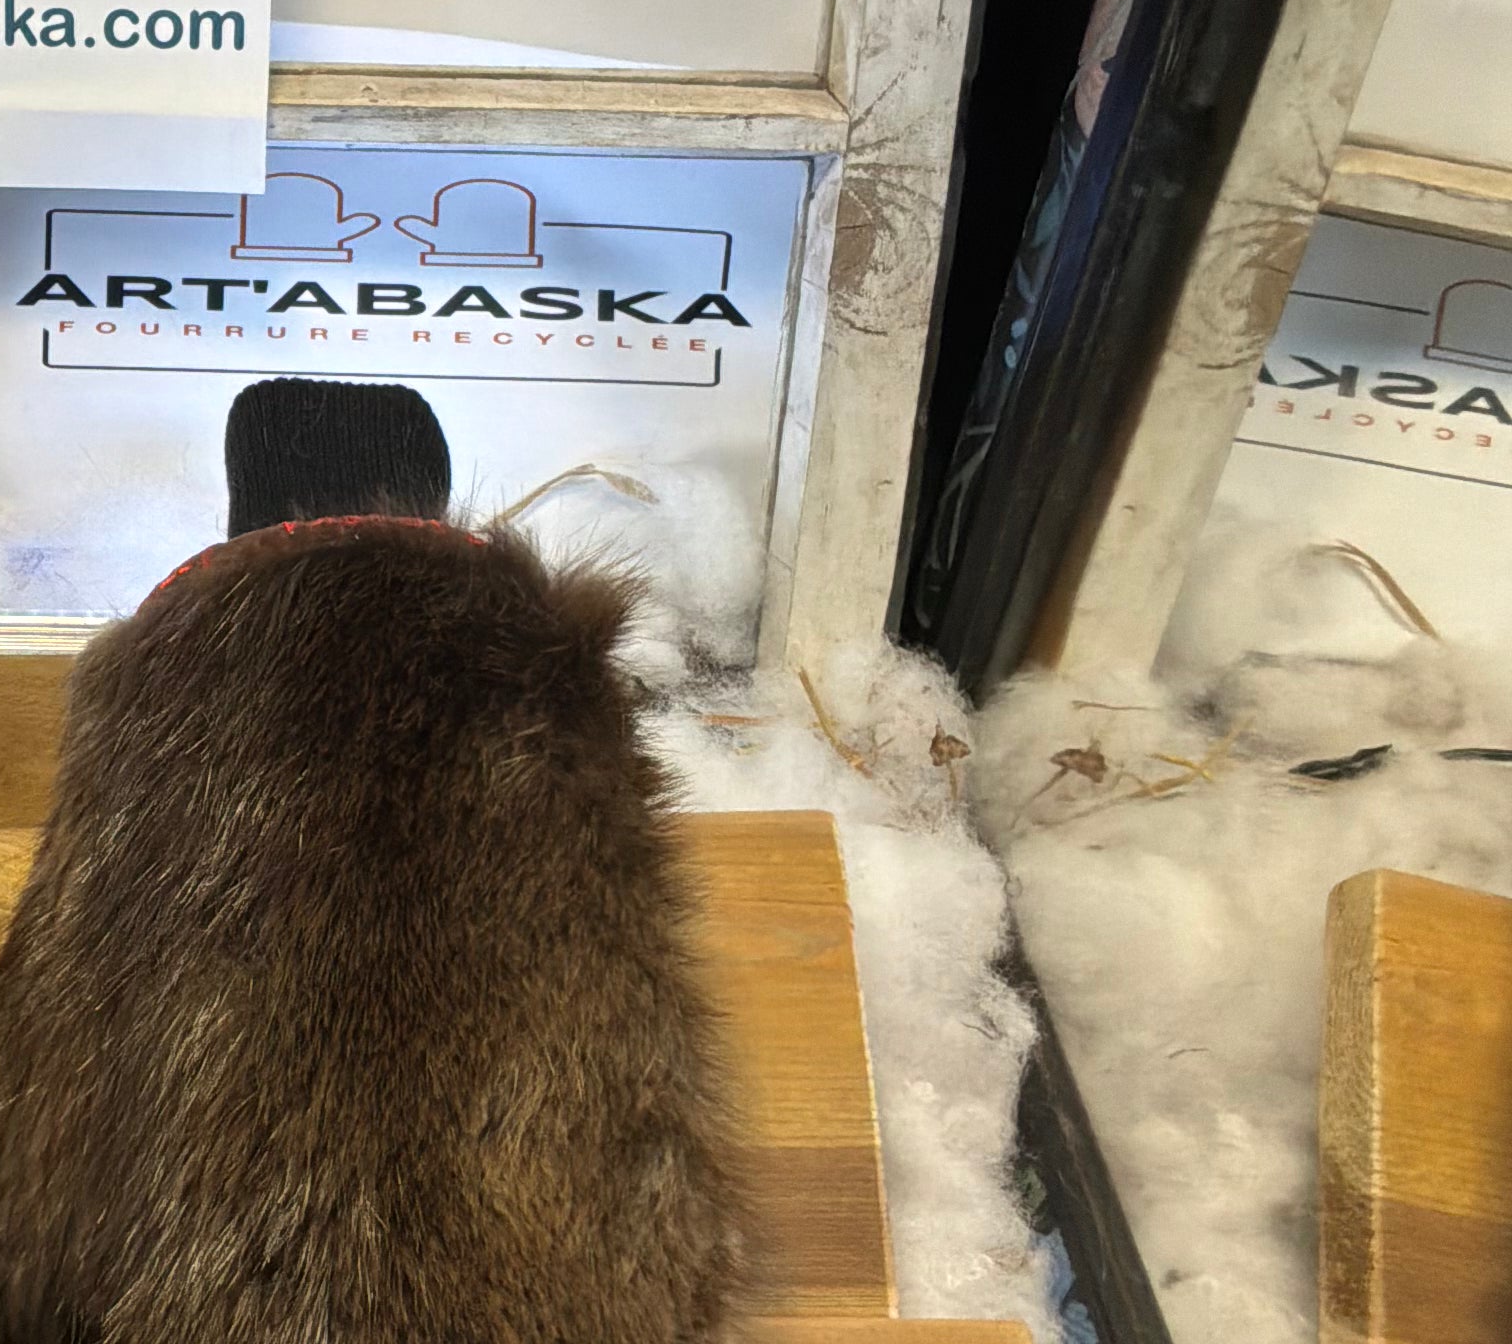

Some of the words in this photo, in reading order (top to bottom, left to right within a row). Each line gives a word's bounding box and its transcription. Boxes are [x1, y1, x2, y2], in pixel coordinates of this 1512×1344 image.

[15, 272, 753, 328] ART'ABASKA
[58, 320, 370, 342] FOURRURE
[412, 330, 707, 353] RECYCLÉE
